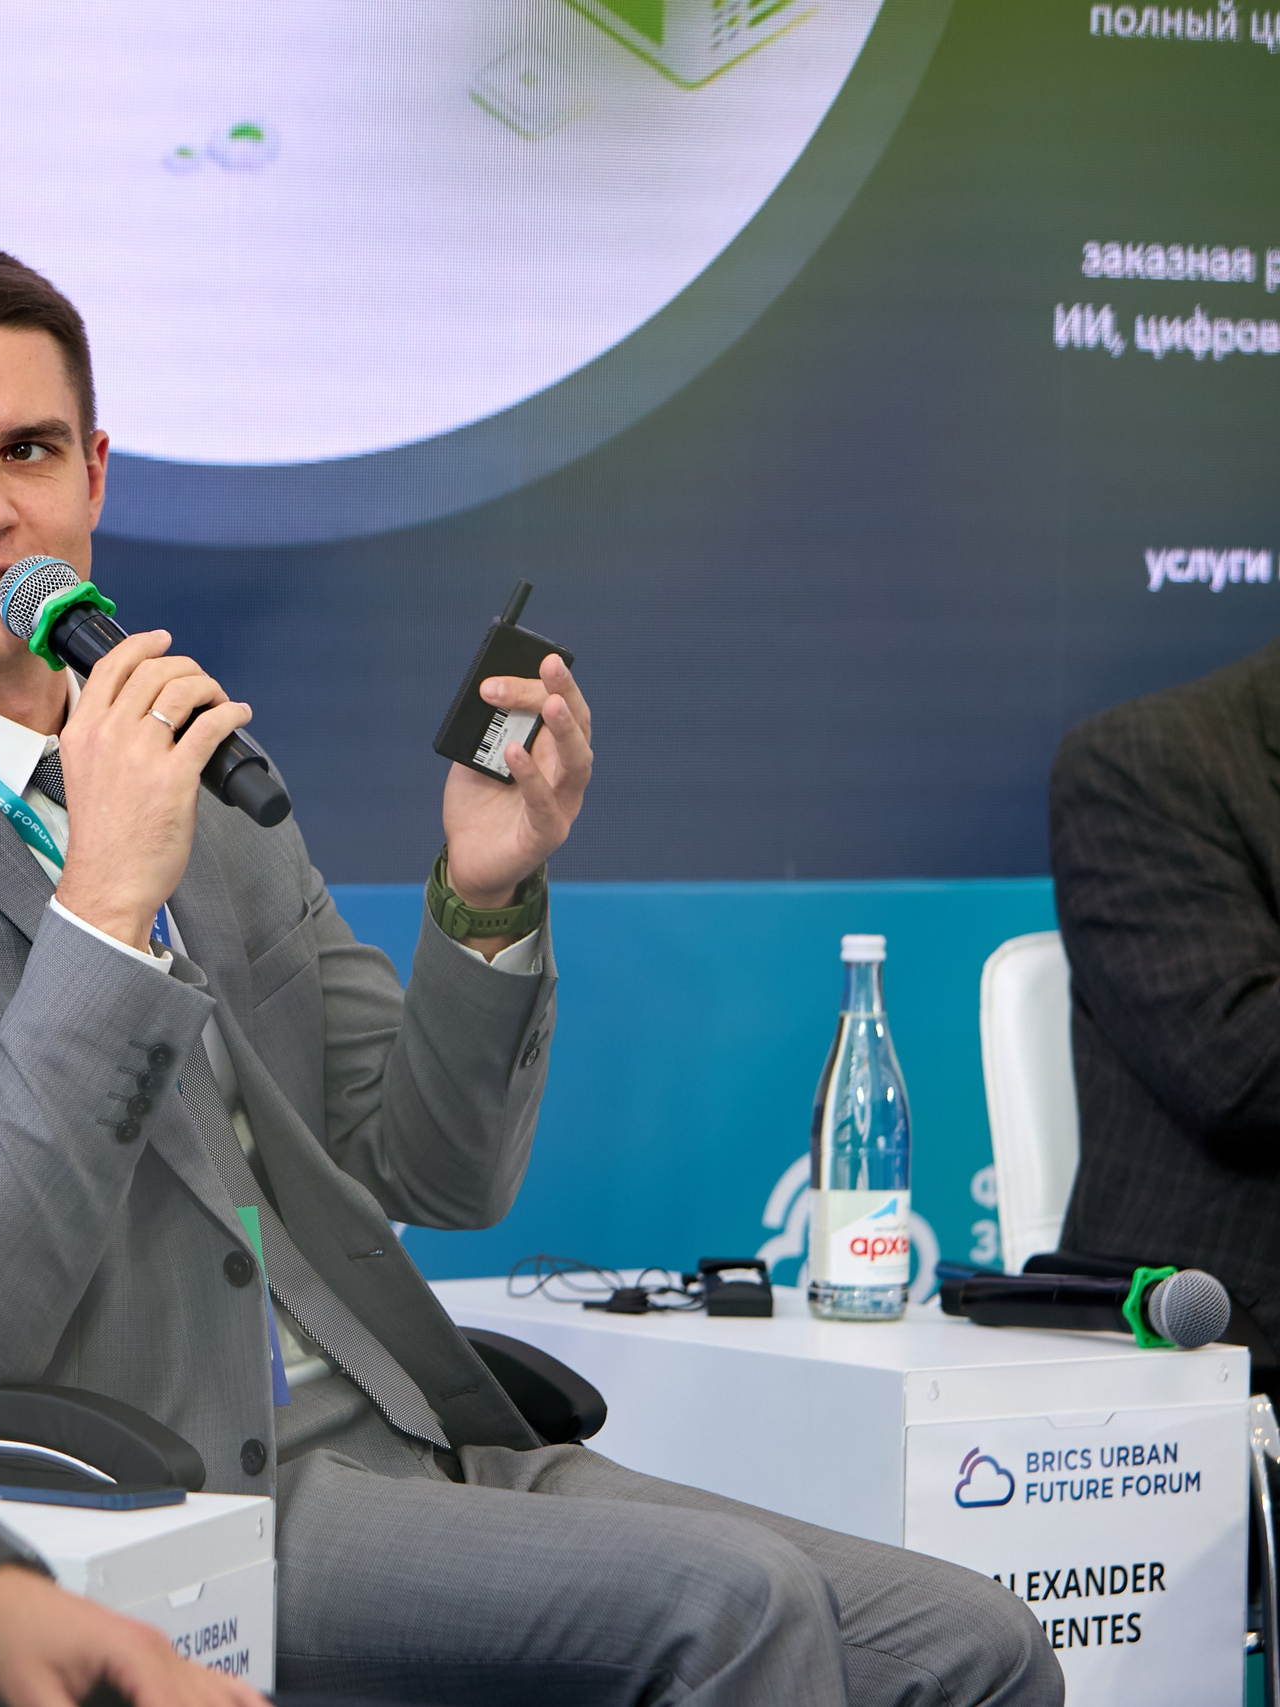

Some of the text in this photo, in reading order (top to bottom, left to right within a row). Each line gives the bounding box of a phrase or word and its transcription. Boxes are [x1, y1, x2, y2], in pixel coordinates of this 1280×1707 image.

[1090, 0, 1238, 42] полный
[1082, 240, 1257, 283] заказная
[1053, 302, 1128, 358] ИИ,
[1143, 546, 1273, 593] услуги
[12, 810, 54, 850] FORUM
[1026, 1443, 1179, 1474] BRICS URBAN
[1025, 1471, 1202, 1504] FUTURE FORUM
[992, 1561, 1166, 1602] LEXANDER
[195, 1615, 238, 1656] URBAN
